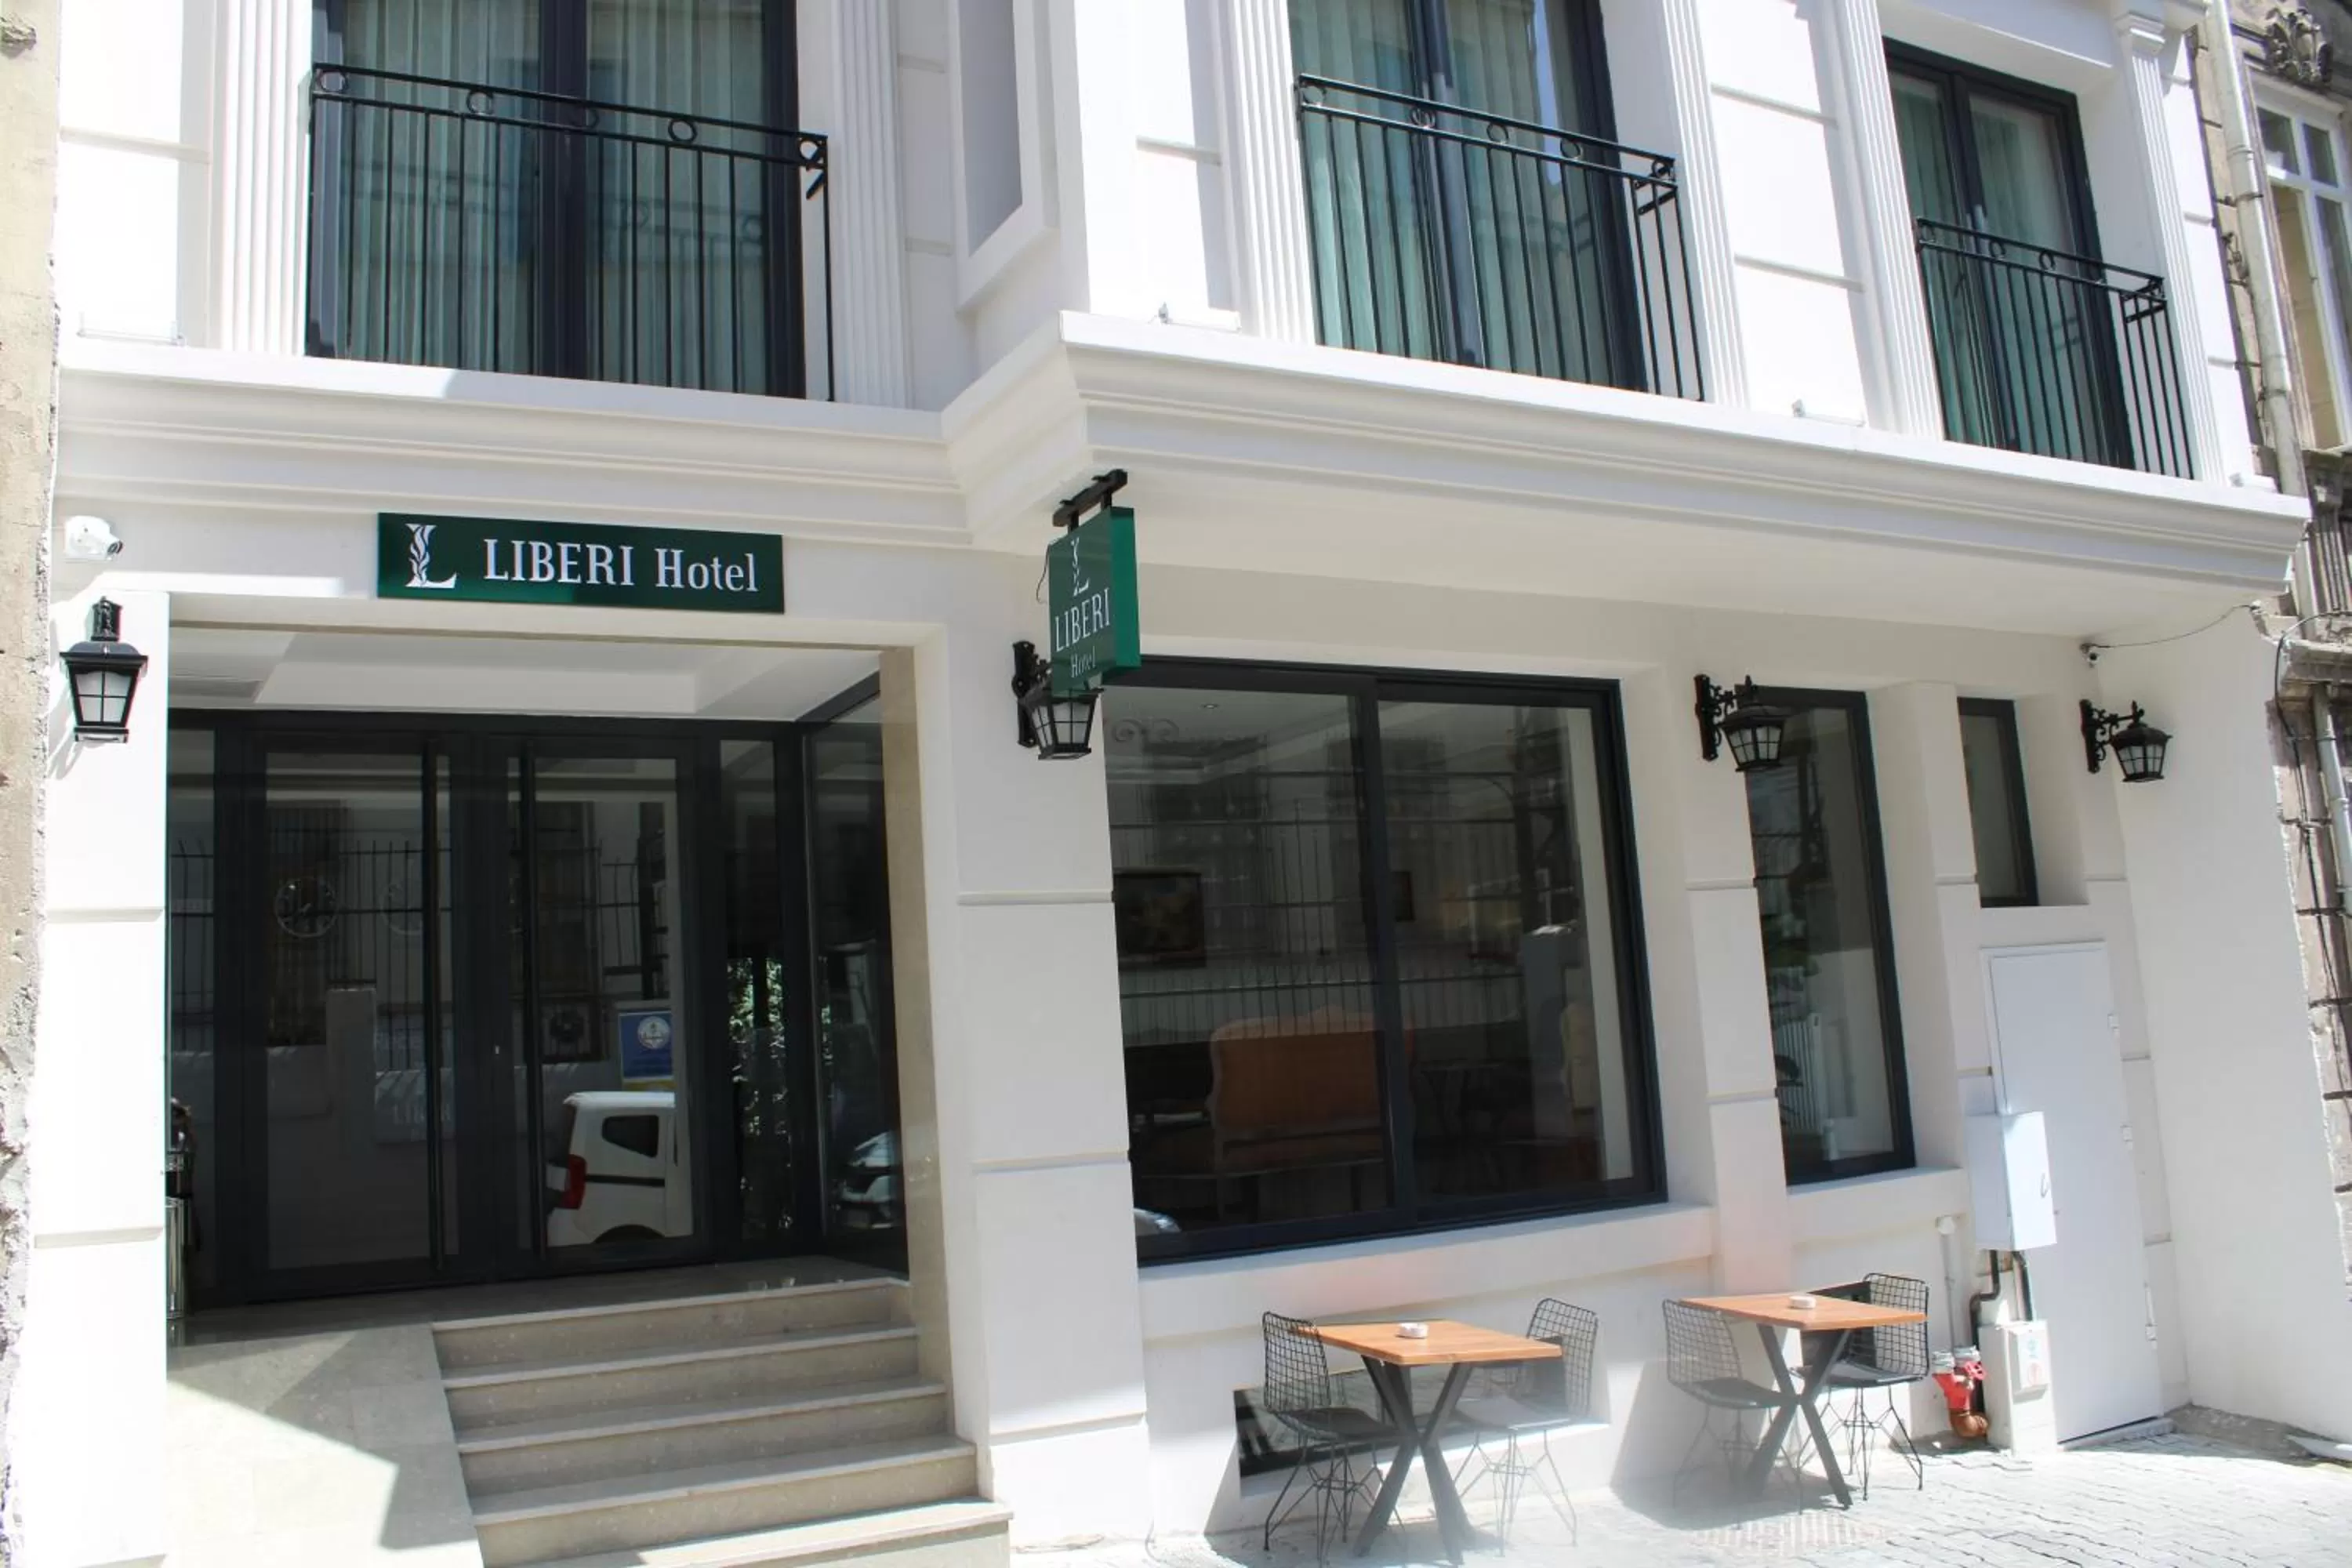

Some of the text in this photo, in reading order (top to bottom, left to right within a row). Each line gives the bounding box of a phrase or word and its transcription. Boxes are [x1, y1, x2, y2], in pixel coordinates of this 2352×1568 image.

[405, 524, 456, 589] L
[484, 539, 759, 592] LIBERI Hotel
[1055, 587, 1110, 652] LIBERI
